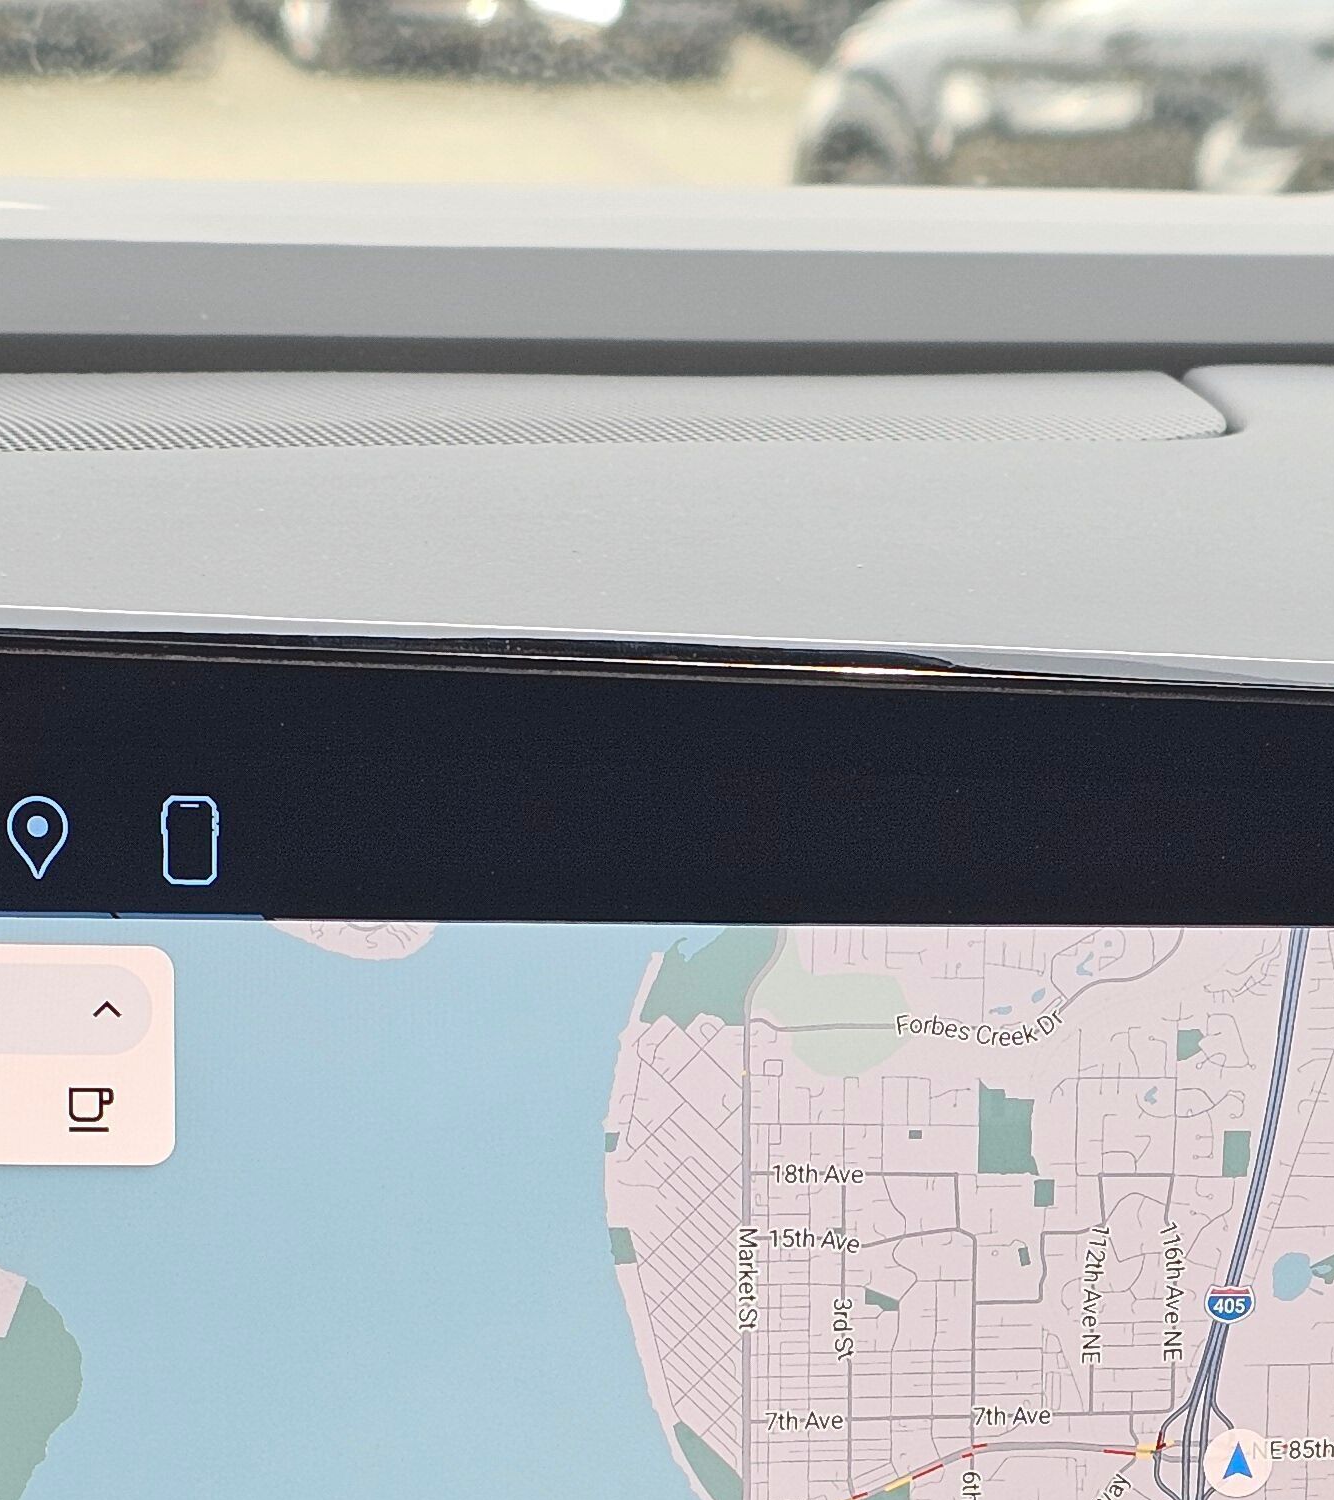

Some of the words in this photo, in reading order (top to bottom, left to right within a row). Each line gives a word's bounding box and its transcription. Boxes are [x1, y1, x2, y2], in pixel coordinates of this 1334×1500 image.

[896, 1016, 970, 1041] Forbes
[976, 1026, 1038, 1046] Creek
[1036, 1010, 1064, 1036] Dr
[773, 1166, 818, 1184] 18th
[824, 1166, 864, 1184] Ave
[769, 1230, 814, 1248] 15th
[819, 1234, 860, 1254] Ave
[1084, 1226, 1110, 1282] 112th
[1160, 1222, 1186, 1280] 116th
[738, 1228, 757, 1304] Market
[738, 1307, 757, 1330] St
[833, 1299, 853, 1334] 3rd
[1082, 1288, 1103, 1328] Ave
[1164, 1284, 1185, 1325] Ave
[1213, 1298, 1246, 1315] 405
[834, 1336, 854, 1360] St
[1081, 1334, 1102, 1364] NE
[1163, 1331, 1183, 1362] NE
[766, 1412, 800, 1430] 7th
[805, 1412, 844, 1430] Ave
[973, 1408, 1007, 1426] 7th
[1010, 1408, 1051, 1426] Ave
[1288, 1440, 1334, 1459] 85th
